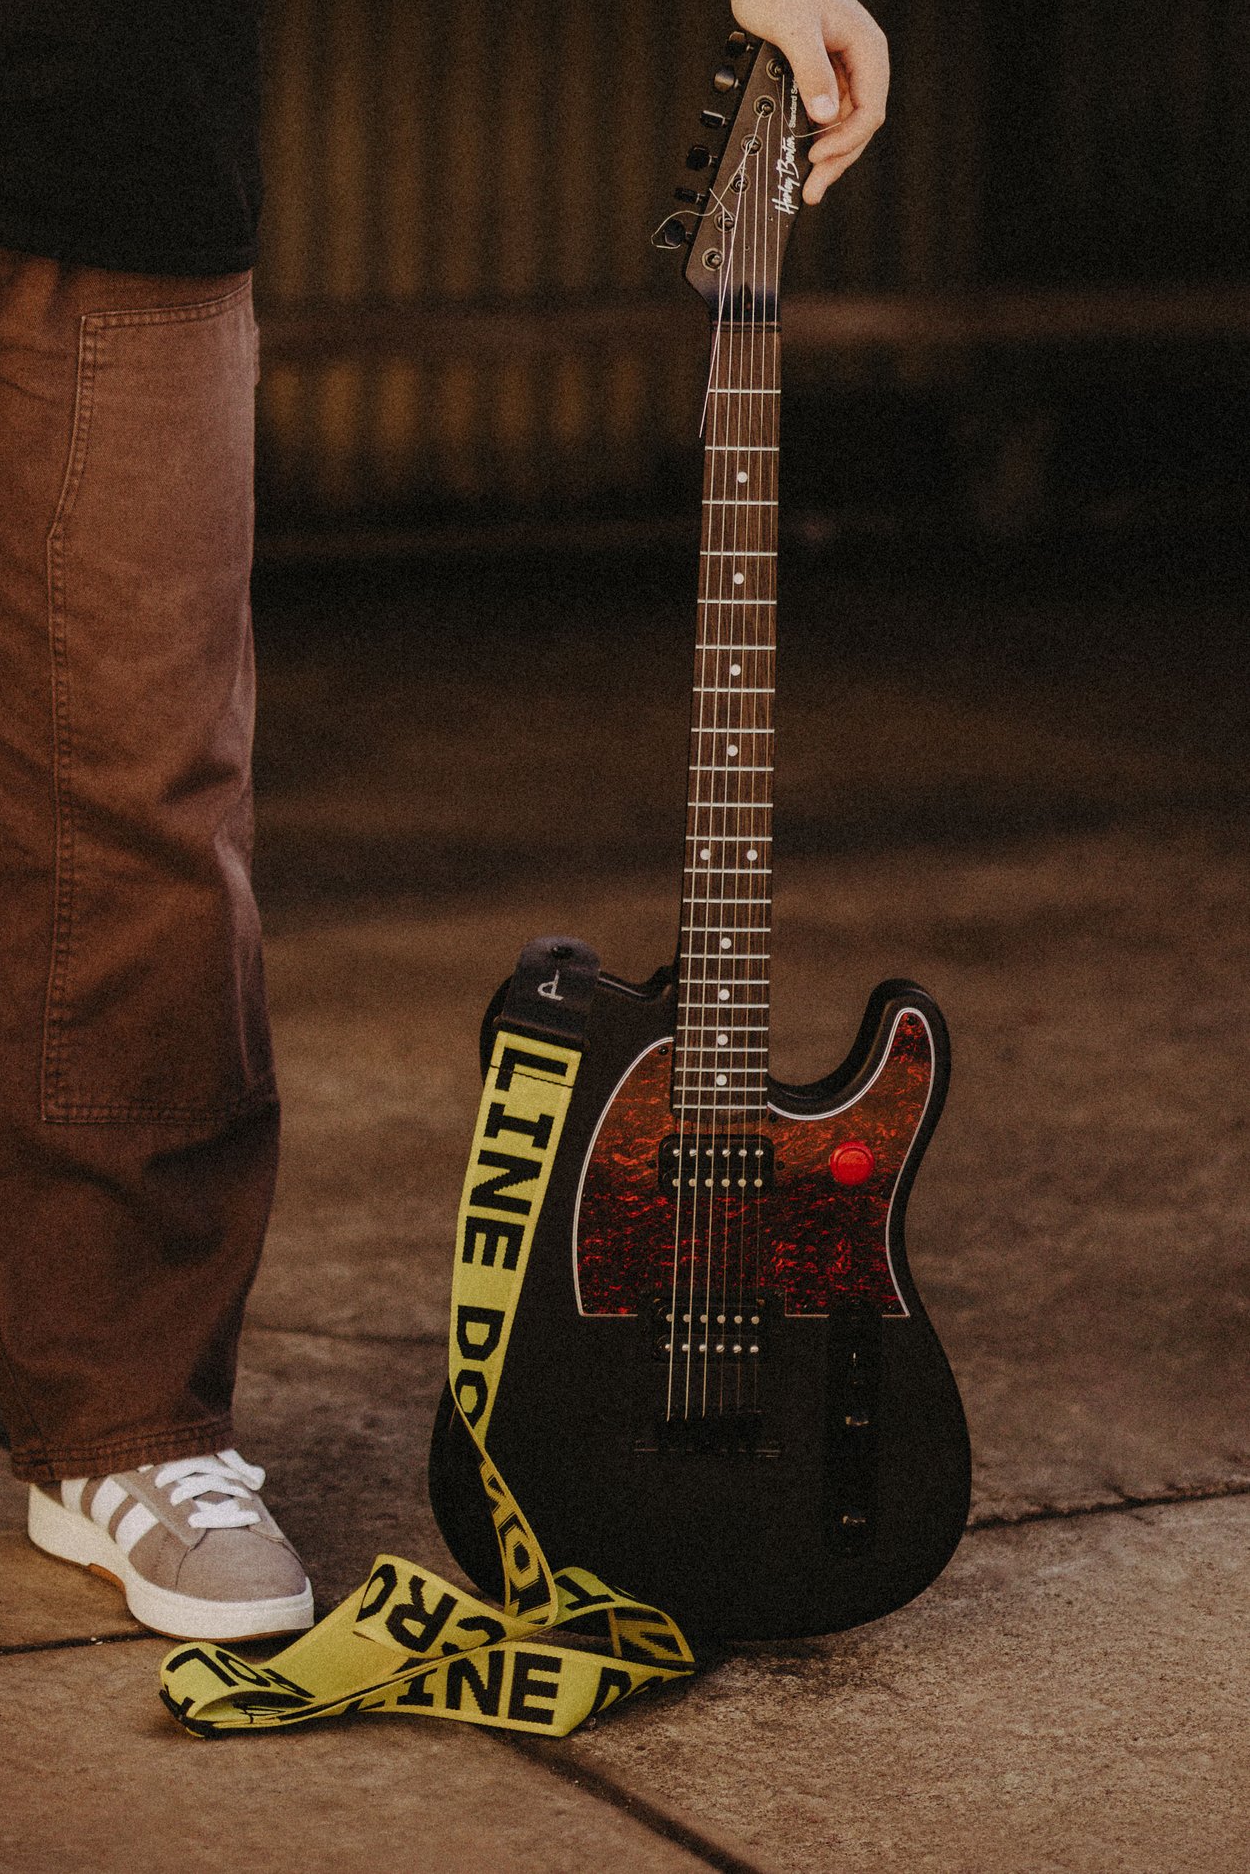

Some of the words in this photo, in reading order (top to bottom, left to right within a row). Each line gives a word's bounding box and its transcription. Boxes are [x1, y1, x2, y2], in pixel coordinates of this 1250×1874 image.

[771, 176, 801, 215] Harley
[788, 95, 798, 129] Standard
[462, 1046, 568, 1272] LINE
[343, 1649, 563, 1726] INE
